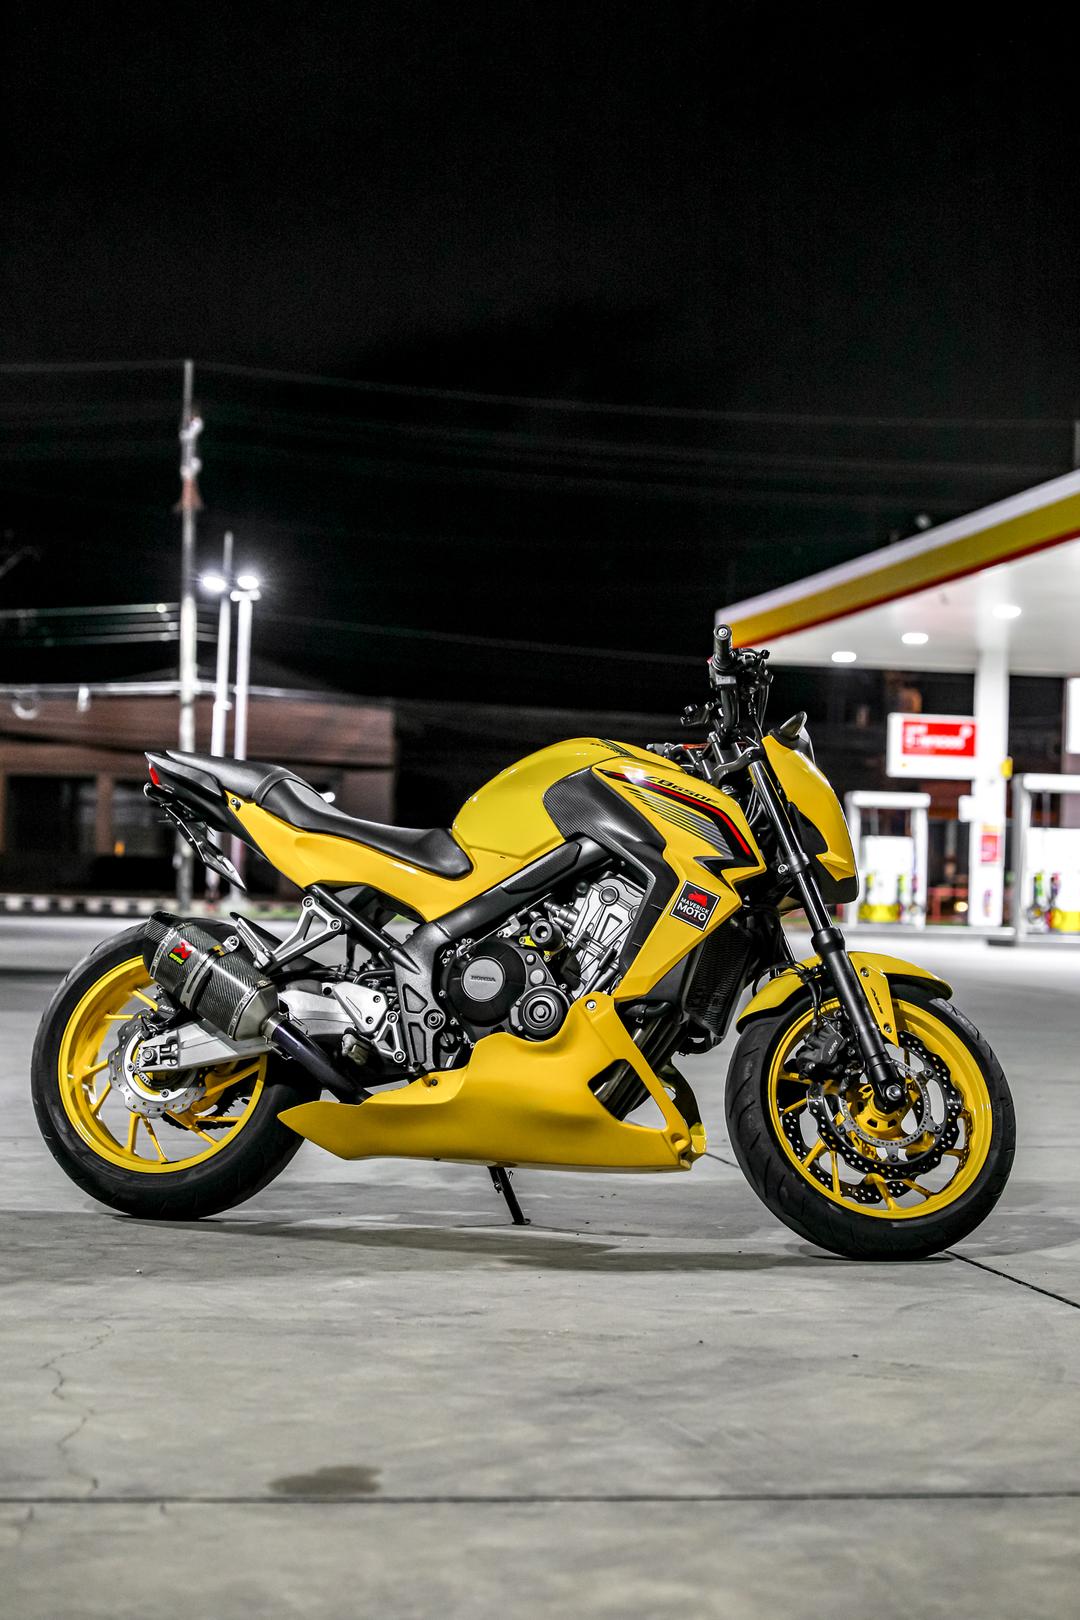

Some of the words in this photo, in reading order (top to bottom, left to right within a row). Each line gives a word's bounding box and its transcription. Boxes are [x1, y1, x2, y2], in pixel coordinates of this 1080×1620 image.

[644, 776, 719, 803] CB650F
[677, 902, 706, 921] MOTO
[681, 897, 710, 915] MAVERICK
